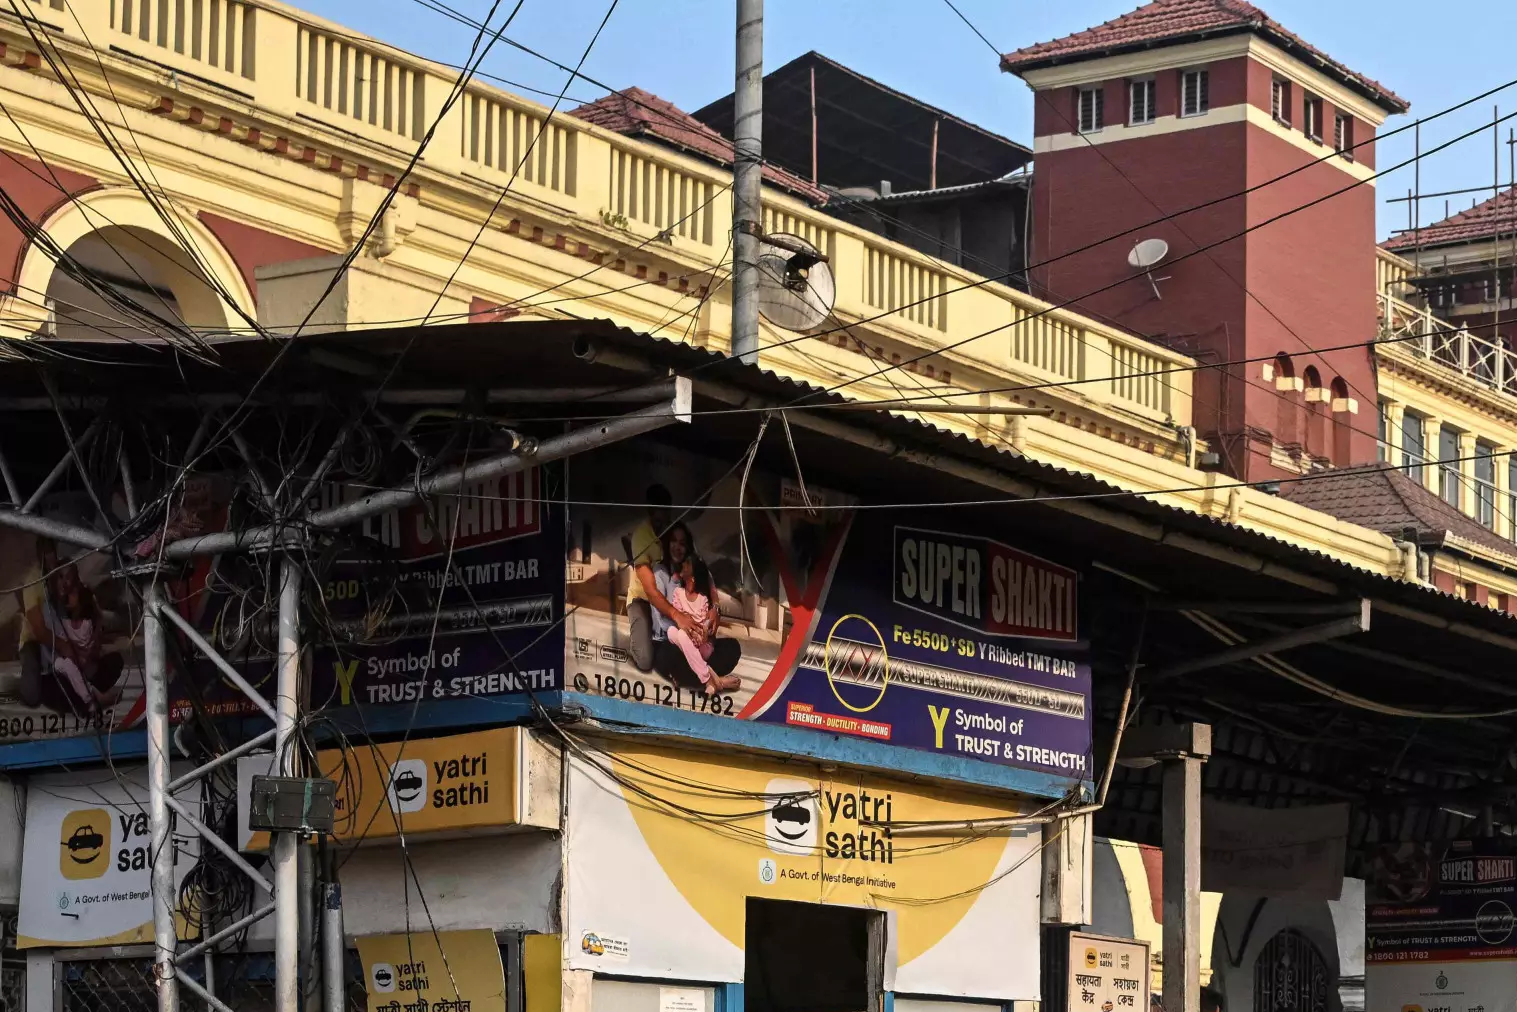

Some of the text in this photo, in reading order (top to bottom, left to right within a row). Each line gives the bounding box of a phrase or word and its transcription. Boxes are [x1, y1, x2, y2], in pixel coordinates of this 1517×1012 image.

[466, 558, 539, 585] TMT BAR
[901, 537, 1073, 633] SUPER SHAKTI
[367, 646, 461, 678] Symbol of
[894, 624, 1076, 679] Fe Y Ribbed TMT BAR
[332, 660, 359, 705] Y
[366, 667, 556, 704] TRUST & STRENGTH
[903, 667, 975, 694] SUPER SHAKTI
[594, 673, 734, 717] 1800 121 1782
[41, 714, 66, 734] 121
[789, 711, 889, 737] STRENGTH DUCTILITY BONDING
[928, 704, 951, 749] Y
[955, 708, 1024, 736] Symbol of
[955, 734, 1087, 771] TRUST & STRENGTH
[434, 752, 488, 784] yatri
[433, 780, 489, 810] sathi
[825, 790, 892, 824] yatri
[825, 829, 893, 864] sathi
[780, 868, 896, 889] A Govt. of West Bengal Initiative
[1441, 858, 1515, 881] SUPER SHAKTI
[75, 889, 150, 905] A Govt. of West Bengal
[1099, 951, 1113, 960] yatri
[1367, 937, 1376, 949] Y
[1410, 937, 1432, 946] TRUST
[1440, 935, 1477, 944] STRENGTH
[1374, 952, 1393, 960] 1800
[1409, 951, 1429, 959] 1782
[396, 960, 426, 978] yatri
[1099, 960, 1113, 968] sathi
[398, 976, 430, 991] sathi
